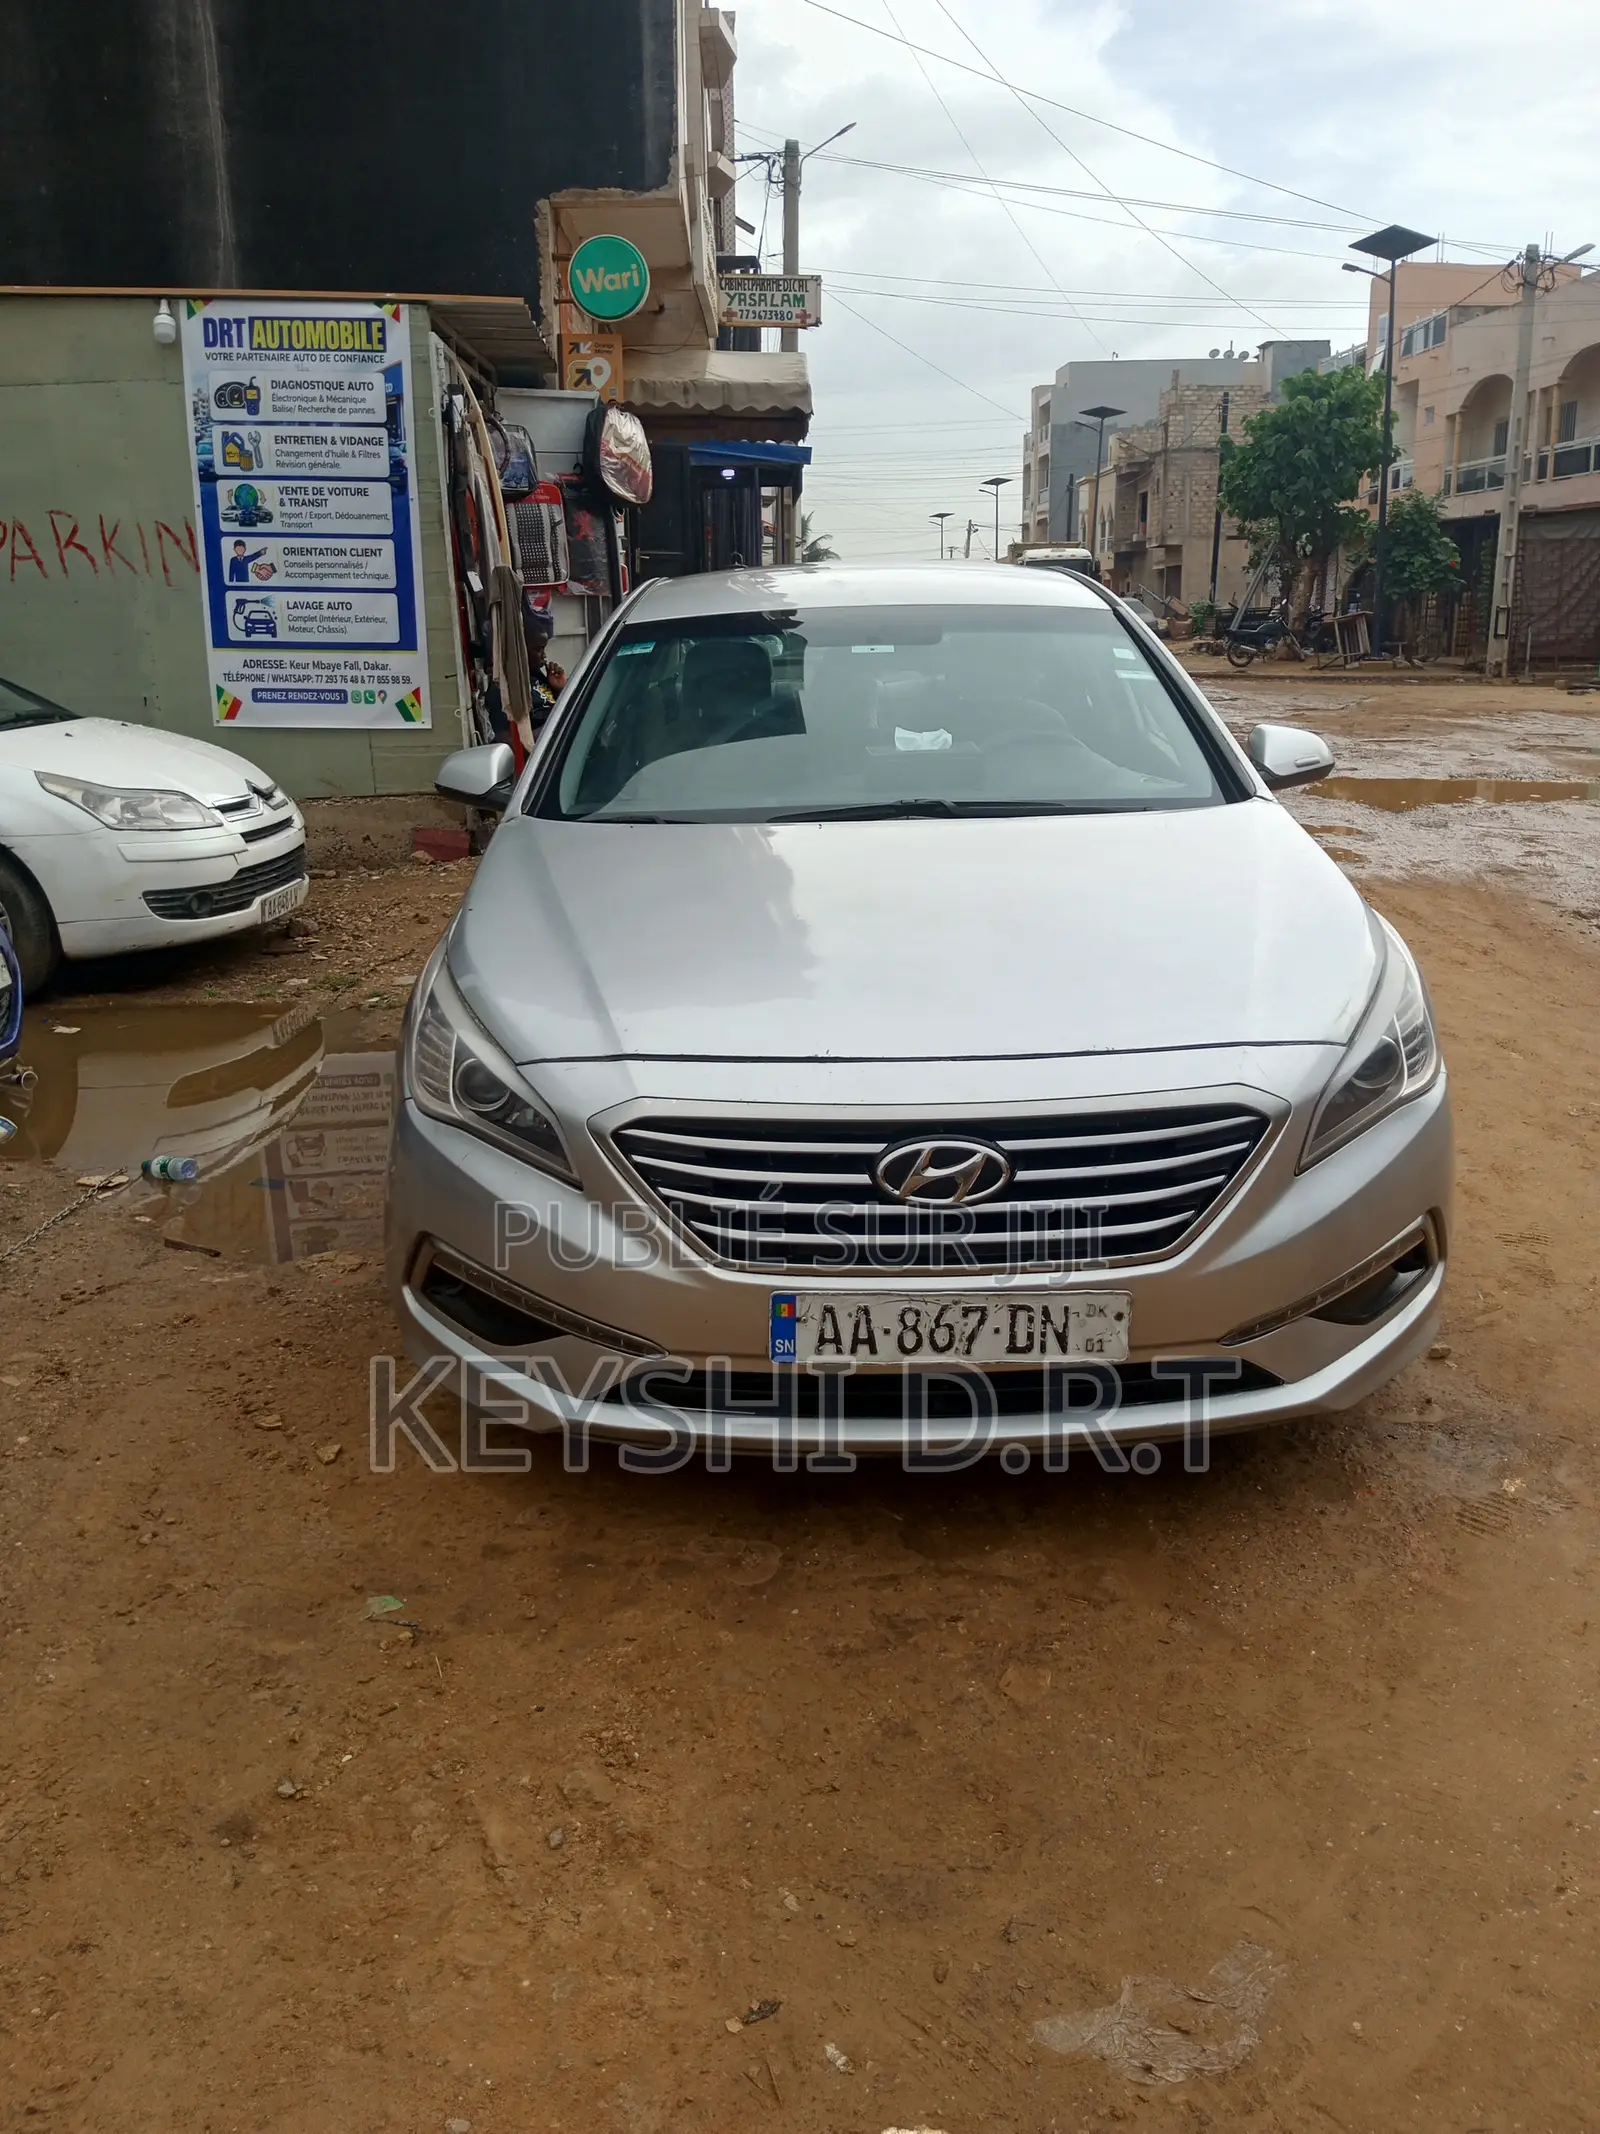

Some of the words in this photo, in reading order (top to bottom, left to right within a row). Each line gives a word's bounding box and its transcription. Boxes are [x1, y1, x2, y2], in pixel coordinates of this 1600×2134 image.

[575, 264, 640, 294] Wari
[725, 292, 806, 308] YASALAM
[203, 317, 246, 349] DRT
[252, 319, 385, 351] AUTOMOBILE
[205, 352, 235, 362] VOTRE
[236, 353, 291, 363] PARTENAIRE
[293, 354, 318, 363] AUTO
[320, 354, 331, 363] DE
[333, 354, 385, 364] CONFIANCE
[271, 380, 346, 392] DIAGNOSTIQUE
[348, 382, 374, 392] AUTO
[272, 393, 318, 404] Électronique
[326, 395, 367, 405] Mécanique
[272, 405, 296, 414] Balise/
[298, 406, 336, 414] Recherche
[275, 436, 329, 446] ENTRETIEN
[331, 437, 339, 446] &
[340, 437, 384, 447] VIDANGE
[276, 449, 323, 460] Changement
[325, 450, 349, 459] d'huile
[351, 451, 357, 459] &
[358, 451, 381, 459] Filtres
[276, 460, 307, 469] Révision
[279, 487, 310, 496] VENTE
[312, 487, 326, 496] DE
[328, 487, 369, 497] VOITURE
[280, 498, 286, 507] &
[288, 498, 329, 508] TRANSIT
[280, 511, 304, 520] Import
[310, 512, 334, 521] Export,
[281, 521, 313, 530] Transport
[283, 547, 347, 557] ORIENTATION
[350, 548, 383, 558] CLIENT
[284, 560, 314, 569] Conseils
[315, 561, 364, 571] personnalisés
[353, 572, 391, 581] technique.
[287, 601, 324, 611] LAVAGE
[327, 602, 353, 611] AUTO
[288, 614, 318, 624] Complet
[319, 615, 354, 624] (Intérieur,
[355, 616, 388, 625] Extérieur,
[289, 625, 316, 634] Moteur,
[243, 659, 287, 669] ADRESSE:
[290, 660, 310, 670] Keur
[312, 661, 342, 672] Mbaye
[344, 661, 362, 672] Fall,
[363, 662, 392, 671] Dakar.
[223, 671, 266, 683] TÉLÉPHONE
[272, 674, 315, 684] WHATSAPP:
[315, 674, 324, 684] 77
[325, 675, 338, 684] 293
[339, 675, 349, 684] 76
[350, 675, 359, 684] 48
[361, 676, 366, 684] &
[367, 675, 376, 684] 77
[377, 676, 390, 685] 855
[391, 676, 401, 685] 98
[402, 676, 413, 685] 59.
[258, 692, 286, 700] PRENEZ
[288, 692, 341, 701] RENDEZ-VOUS
[1086, 1303, 1109, 1319] DK
[775, 1339, 795, 1353] SN
